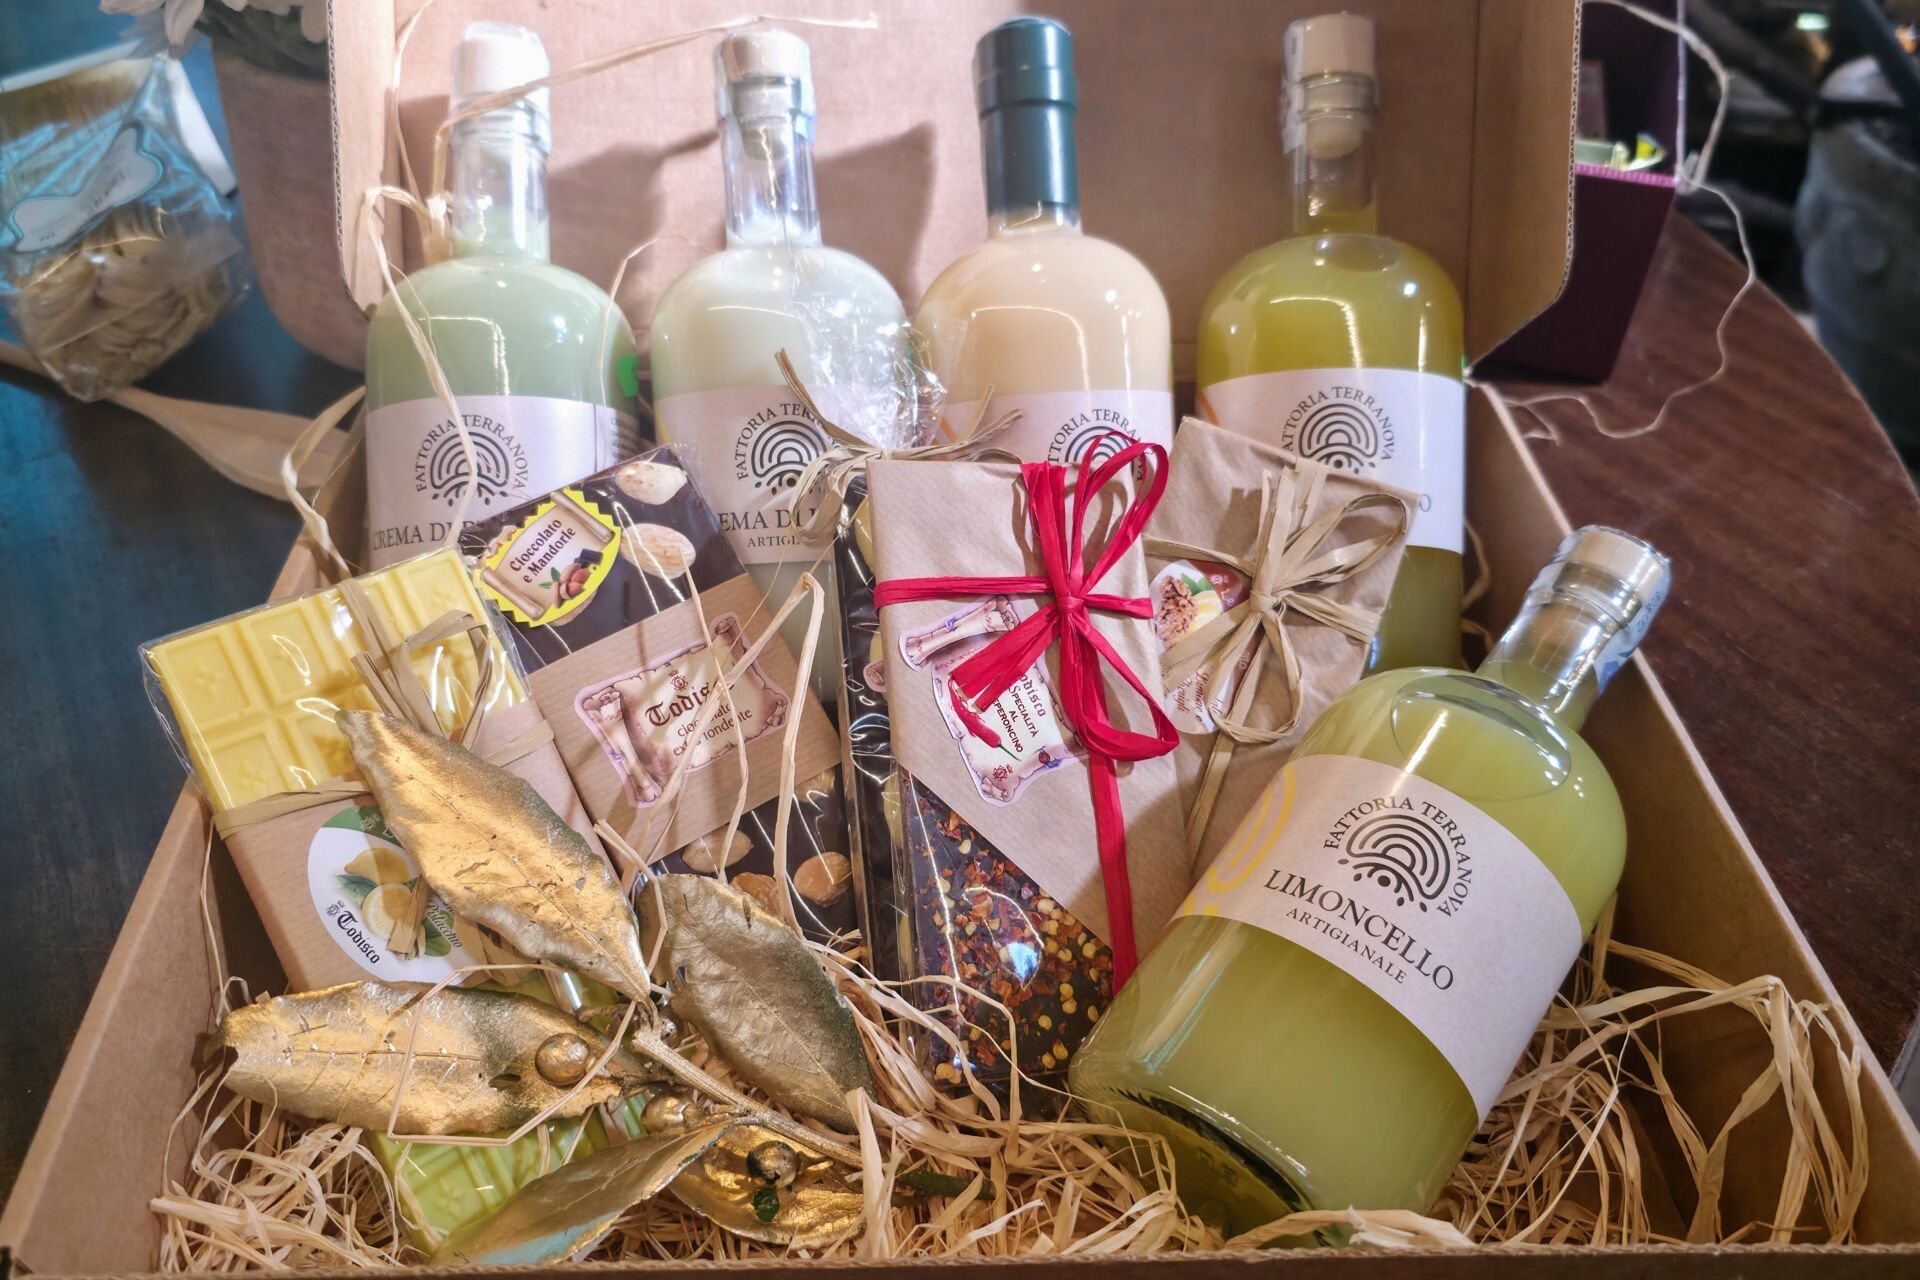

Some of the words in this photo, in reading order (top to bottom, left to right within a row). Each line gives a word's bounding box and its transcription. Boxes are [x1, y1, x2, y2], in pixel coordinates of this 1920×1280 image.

[735, 407, 778, 481] FATTORIA
[1047, 412, 1090, 463] TTORIA
[1281, 389, 1329, 453] ATTORIA
[1331, 386, 1395, 461] TERRANOVA
[415, 419, 458, 492] FATTORIA
[461, 414, 529, 490] TERRANOVA
[373, 523, 425, 551] CREMA
[430, 521, 453, 542] D
[509, 518, 562, 572] Cioccolato
[718, 510, 769, 532] EMA
[523, 574, 533, 584] e
[530, 526, 576, 576] Mandorle
[1008, 709, 1019, 723] AL
[1019, 673, 1046, 717] odisco
[703, 709, 752, 741] fondete
[993, 698, 1024, 753] EPERONCINO
[1323, 796, 1415, 849] FATTORIA
[1421, 801, 1473, 918] TERRANOVA
[336, 910, 381, 964] Todisco
[1263, 869, 1454, 991] LIMONCELLO
[1286, 907, 1407, 984] ARTIGIANALE
